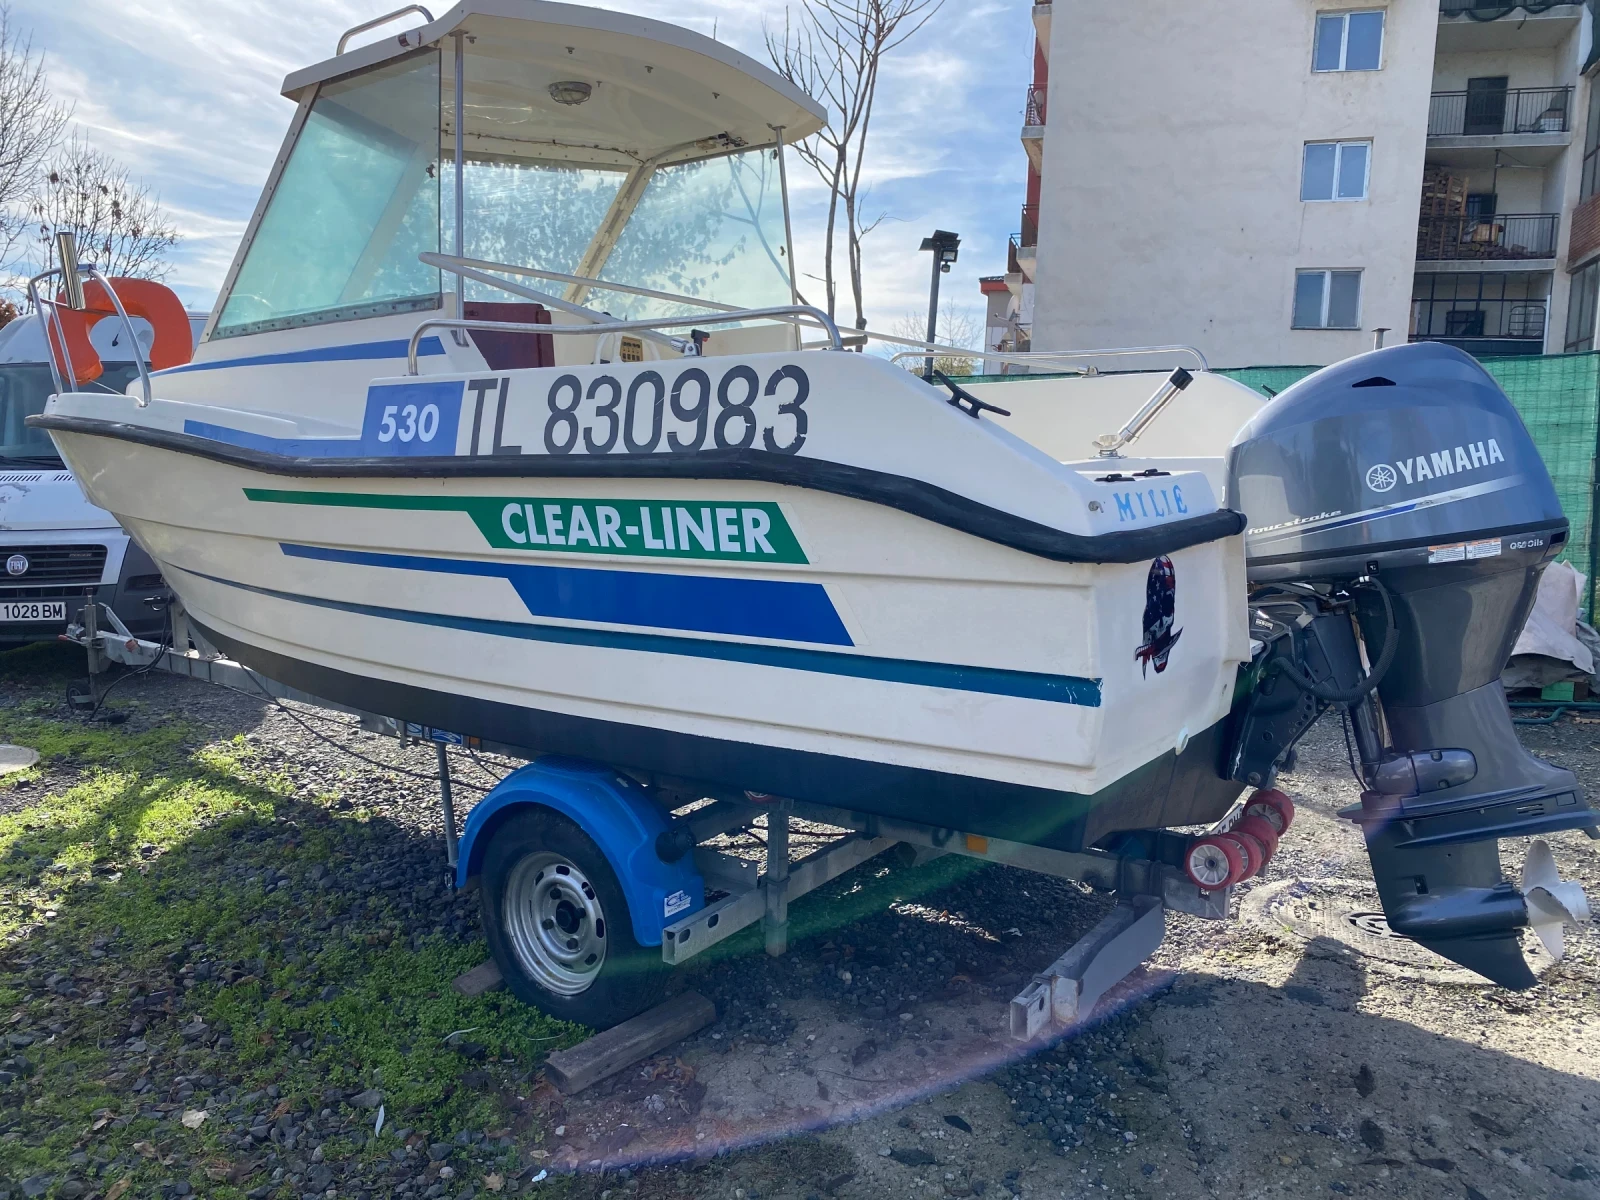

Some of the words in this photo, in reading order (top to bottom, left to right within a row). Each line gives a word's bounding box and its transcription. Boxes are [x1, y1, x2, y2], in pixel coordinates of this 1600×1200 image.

[377, 403, 440, 443] 530
[467, 377, 522, 456] TL
[543, 364, 810, 456] 830983
[1395, 438, 1505, 485] YAMAHA
[501, 502, 777, 555] CLEAR-LINER
[10, 560, 24, 571] FIAT
[3, 604, 40, 619] 1028
[42, 603, 63, 619] BM
